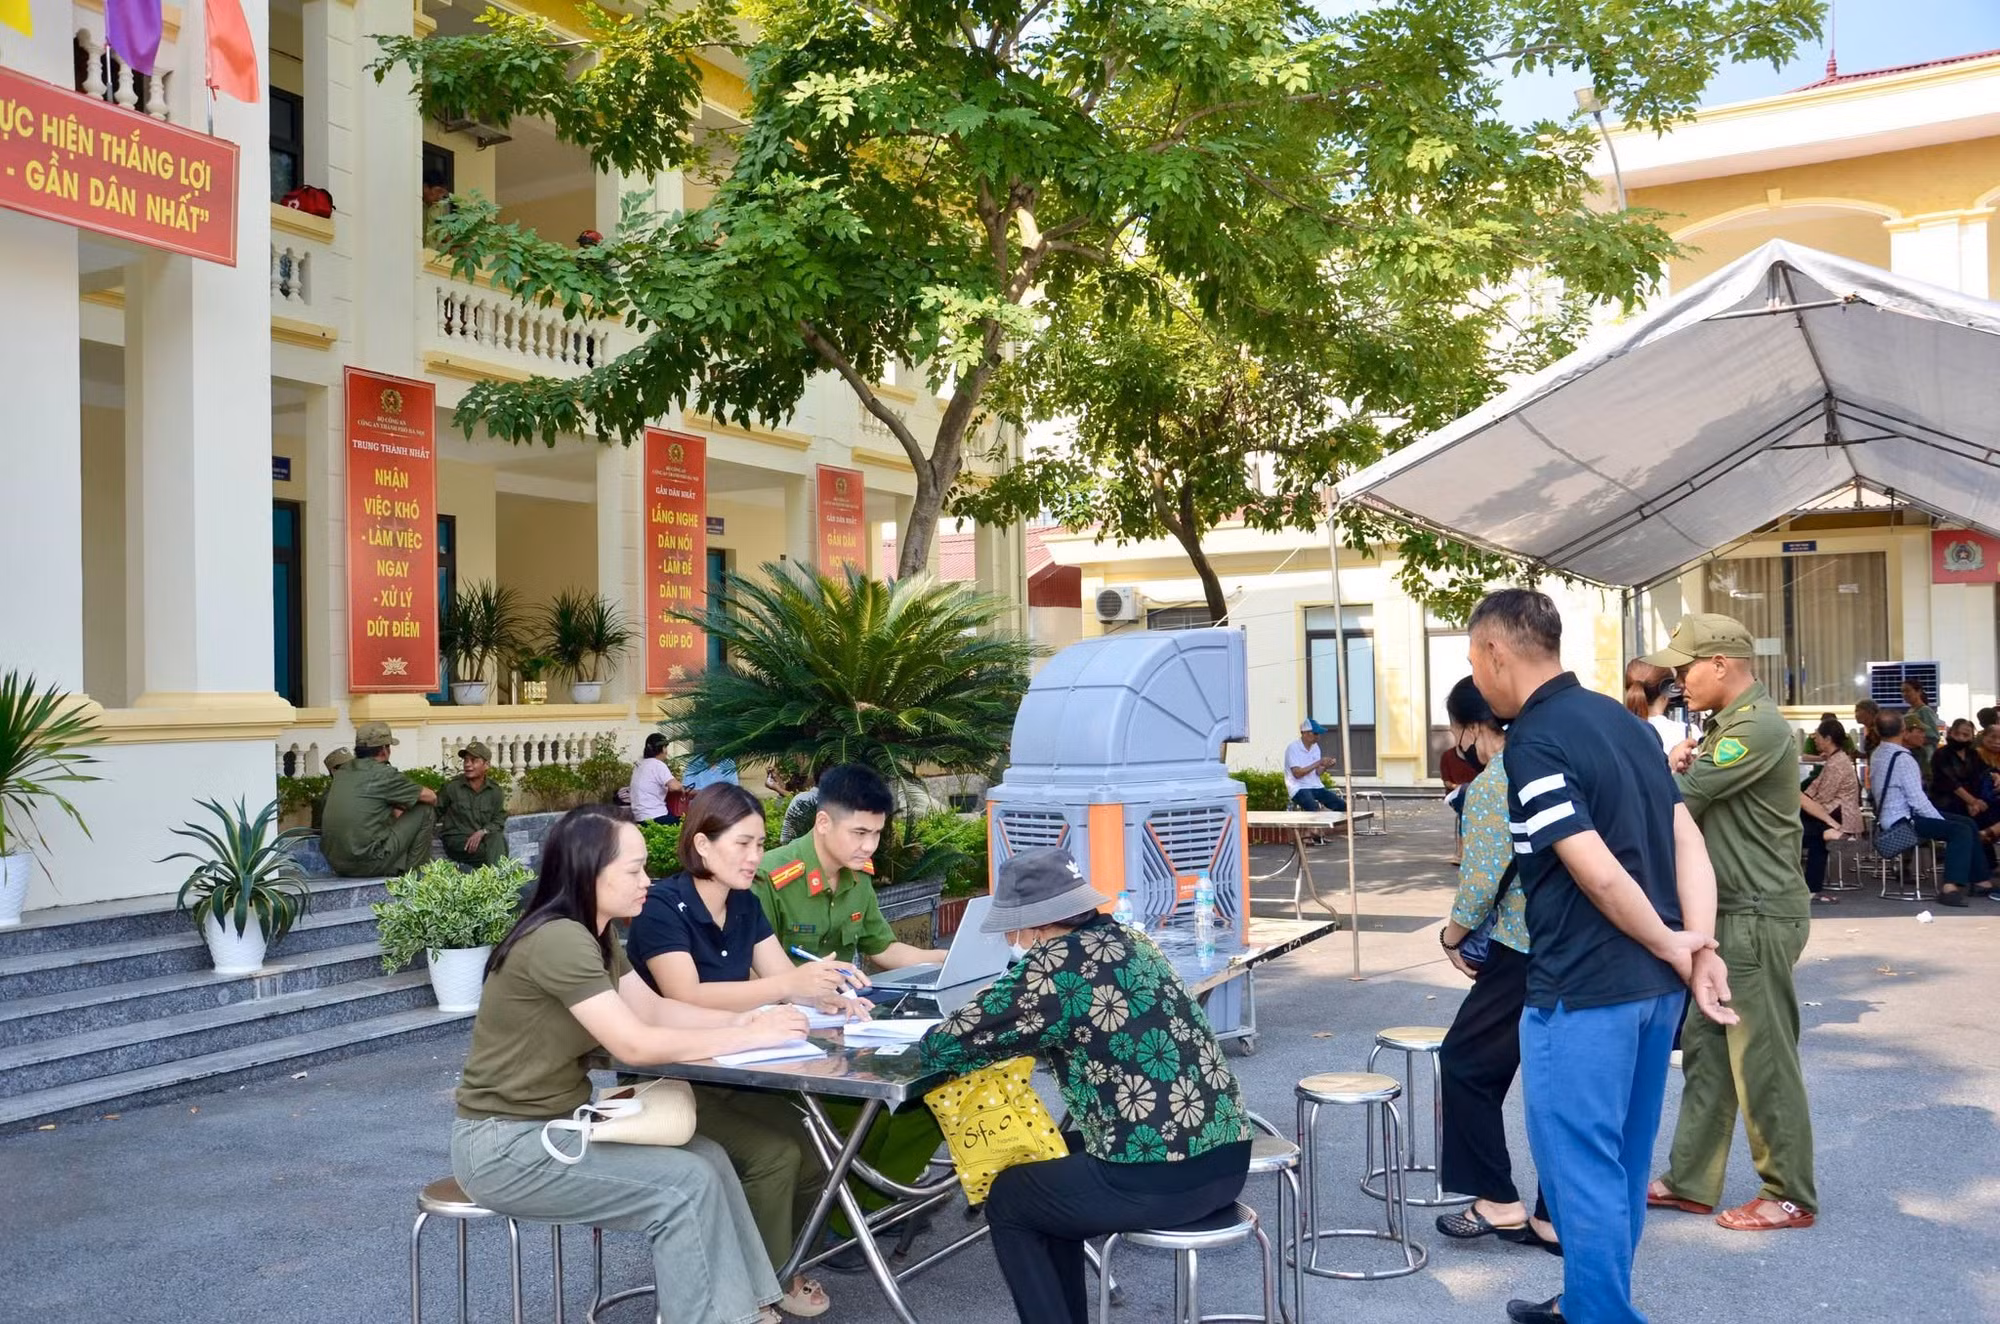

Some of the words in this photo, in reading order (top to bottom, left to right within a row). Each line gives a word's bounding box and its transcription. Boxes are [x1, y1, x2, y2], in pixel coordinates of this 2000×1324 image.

[42, 113, 94, 160] HIỆN
[100, 128, 174, 180] THẮNG
[180, 157, 211, 197] LỢI
[25, 150, 79, 202] GẦN
[89, 175, 137, 217] DÂN
[146, 192, 210, 234] NHẤT”
[352, 439, 379, 452] TRUNG
[380, 442, 408, 456] THÀNH
[409, 445, 430, 460] NHẤT
[375, 466, 409, 493] NHẬN
[364, 494, 391, 521] VIỆC
[394, 498, 420, 520] KHÓ
[652, 502, 675, 525] LẮNG
[676, 511, 698, 528] NGHE
[368, 524, 393, 547] LÀM
[396, 528, 422, 554] VIỆC
[658, 531, 676, 549] DÂN
[677, 532, 693, 551] NÓI
[376, 559, 409, 578] NGAY
[381, 584, 398, 608] XỬ
[400, 586, 413, 608] LÝ
[660, 580, 677, 599] DÂN
[679, 585, 692, 600] TIN
[367, 615, 390, 638] DỨT
[392, 612, 420, 638] ĐIỂM
[658, 630, 679, 649] GIÚP
[680, 631, 693, 650] ĐỠ
[964, 1119, 996, 1149] Sifa
